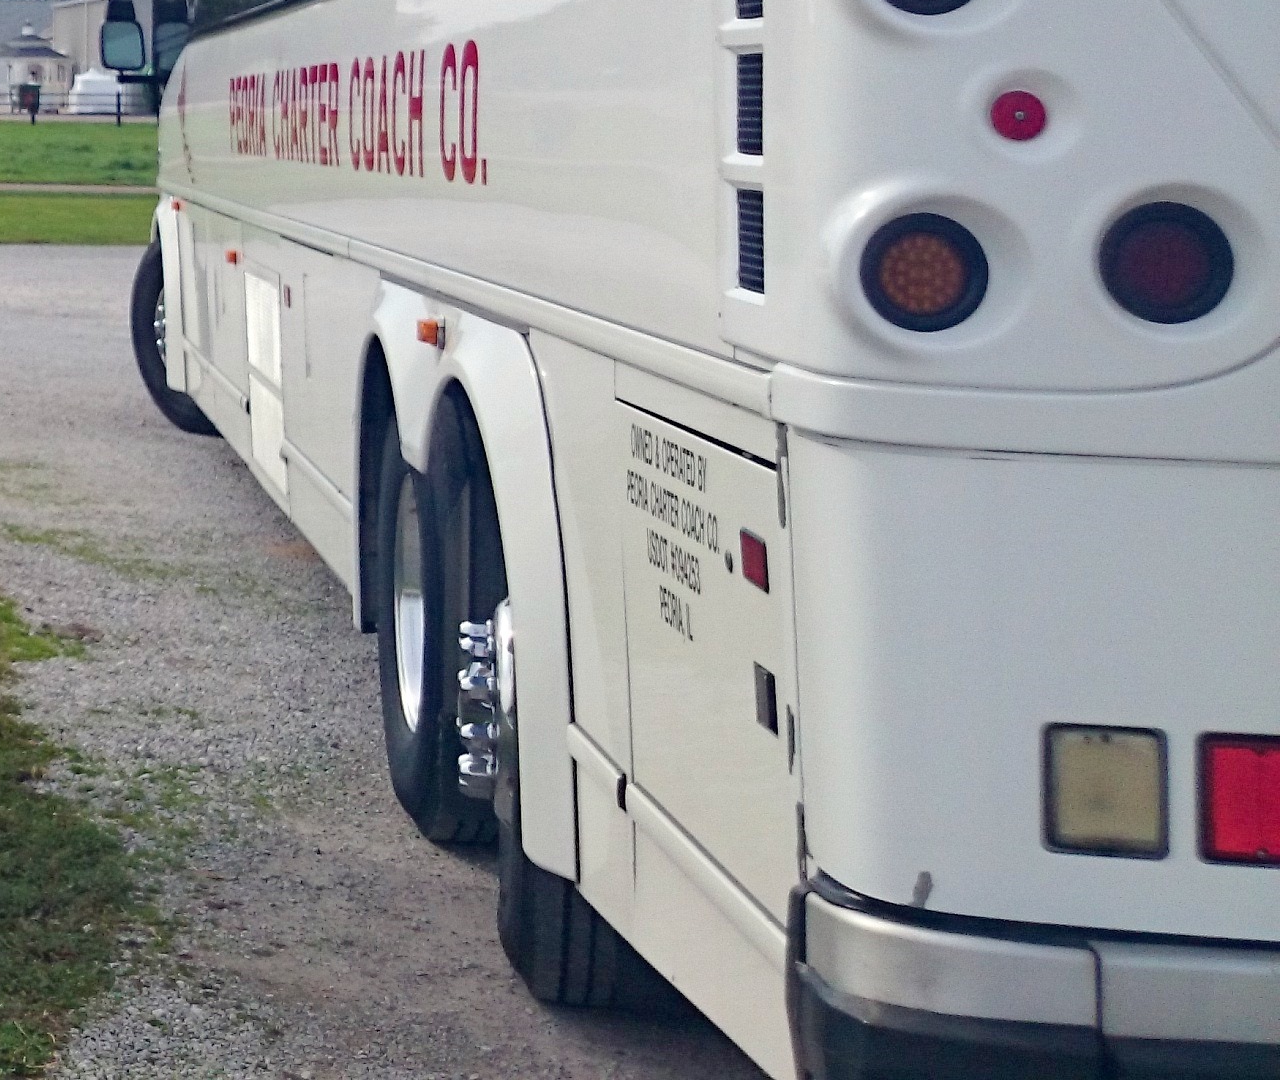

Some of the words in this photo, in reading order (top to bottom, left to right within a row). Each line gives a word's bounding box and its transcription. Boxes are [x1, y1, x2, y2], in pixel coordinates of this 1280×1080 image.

[230, 73, 266, 157] PEORIA
[272, 62, 339, 166] CHARTER
[349, 49, 425, 178] COACH
[440, 39, 487, 185] CO.
[631, 423, 652, 465] OWNED
[656, 435, 660, 469] &
[662, 437, 695, 487] OPERATED
[698, 455, 707, 493] BY
[627, 469, 648, 512] PEORIA
[651, 481, 678, 530] CHARTER
[683, 498, 704, 545] COACH
[707, 512, 720, 554] CO.
[647, 528, 668, 573] USDOT
[686, 603, 693, 641] IL
